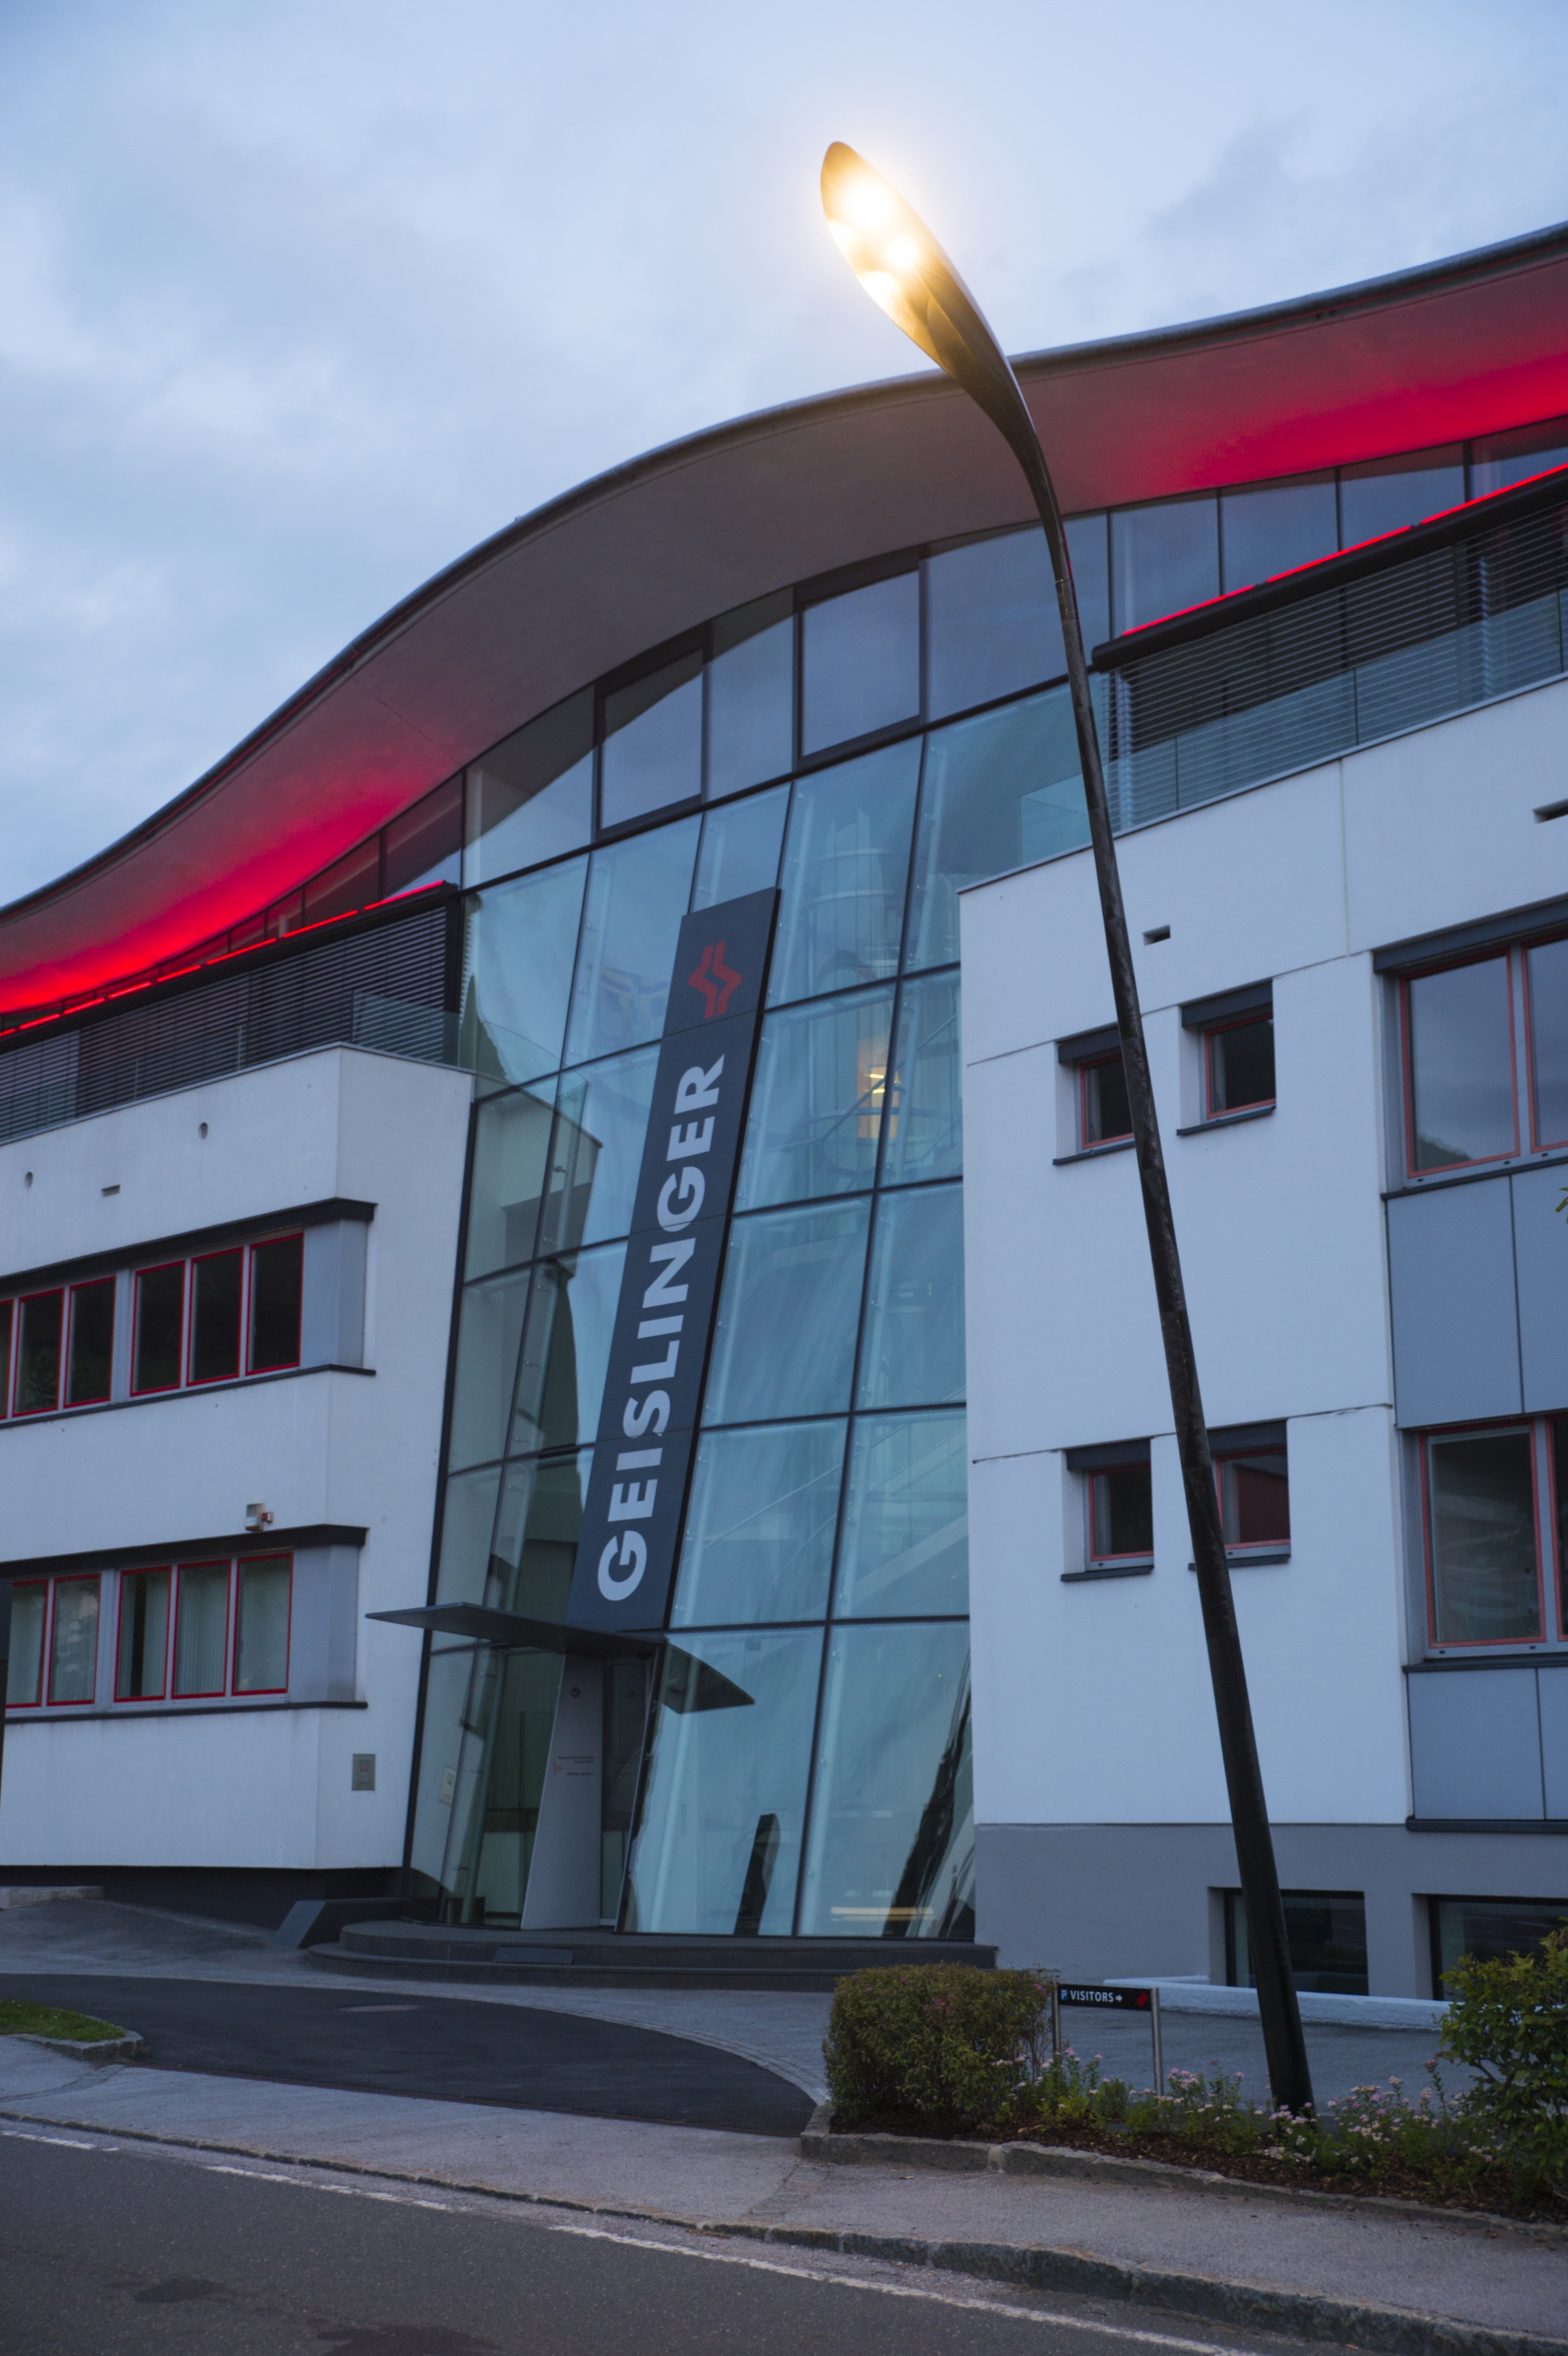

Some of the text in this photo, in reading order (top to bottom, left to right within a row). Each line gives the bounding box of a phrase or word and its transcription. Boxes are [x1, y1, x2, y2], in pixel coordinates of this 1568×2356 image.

[597, 1053, 726, 1602] GEISLINGER
[1061, 1990, 1114, 2002] P VISITORS
